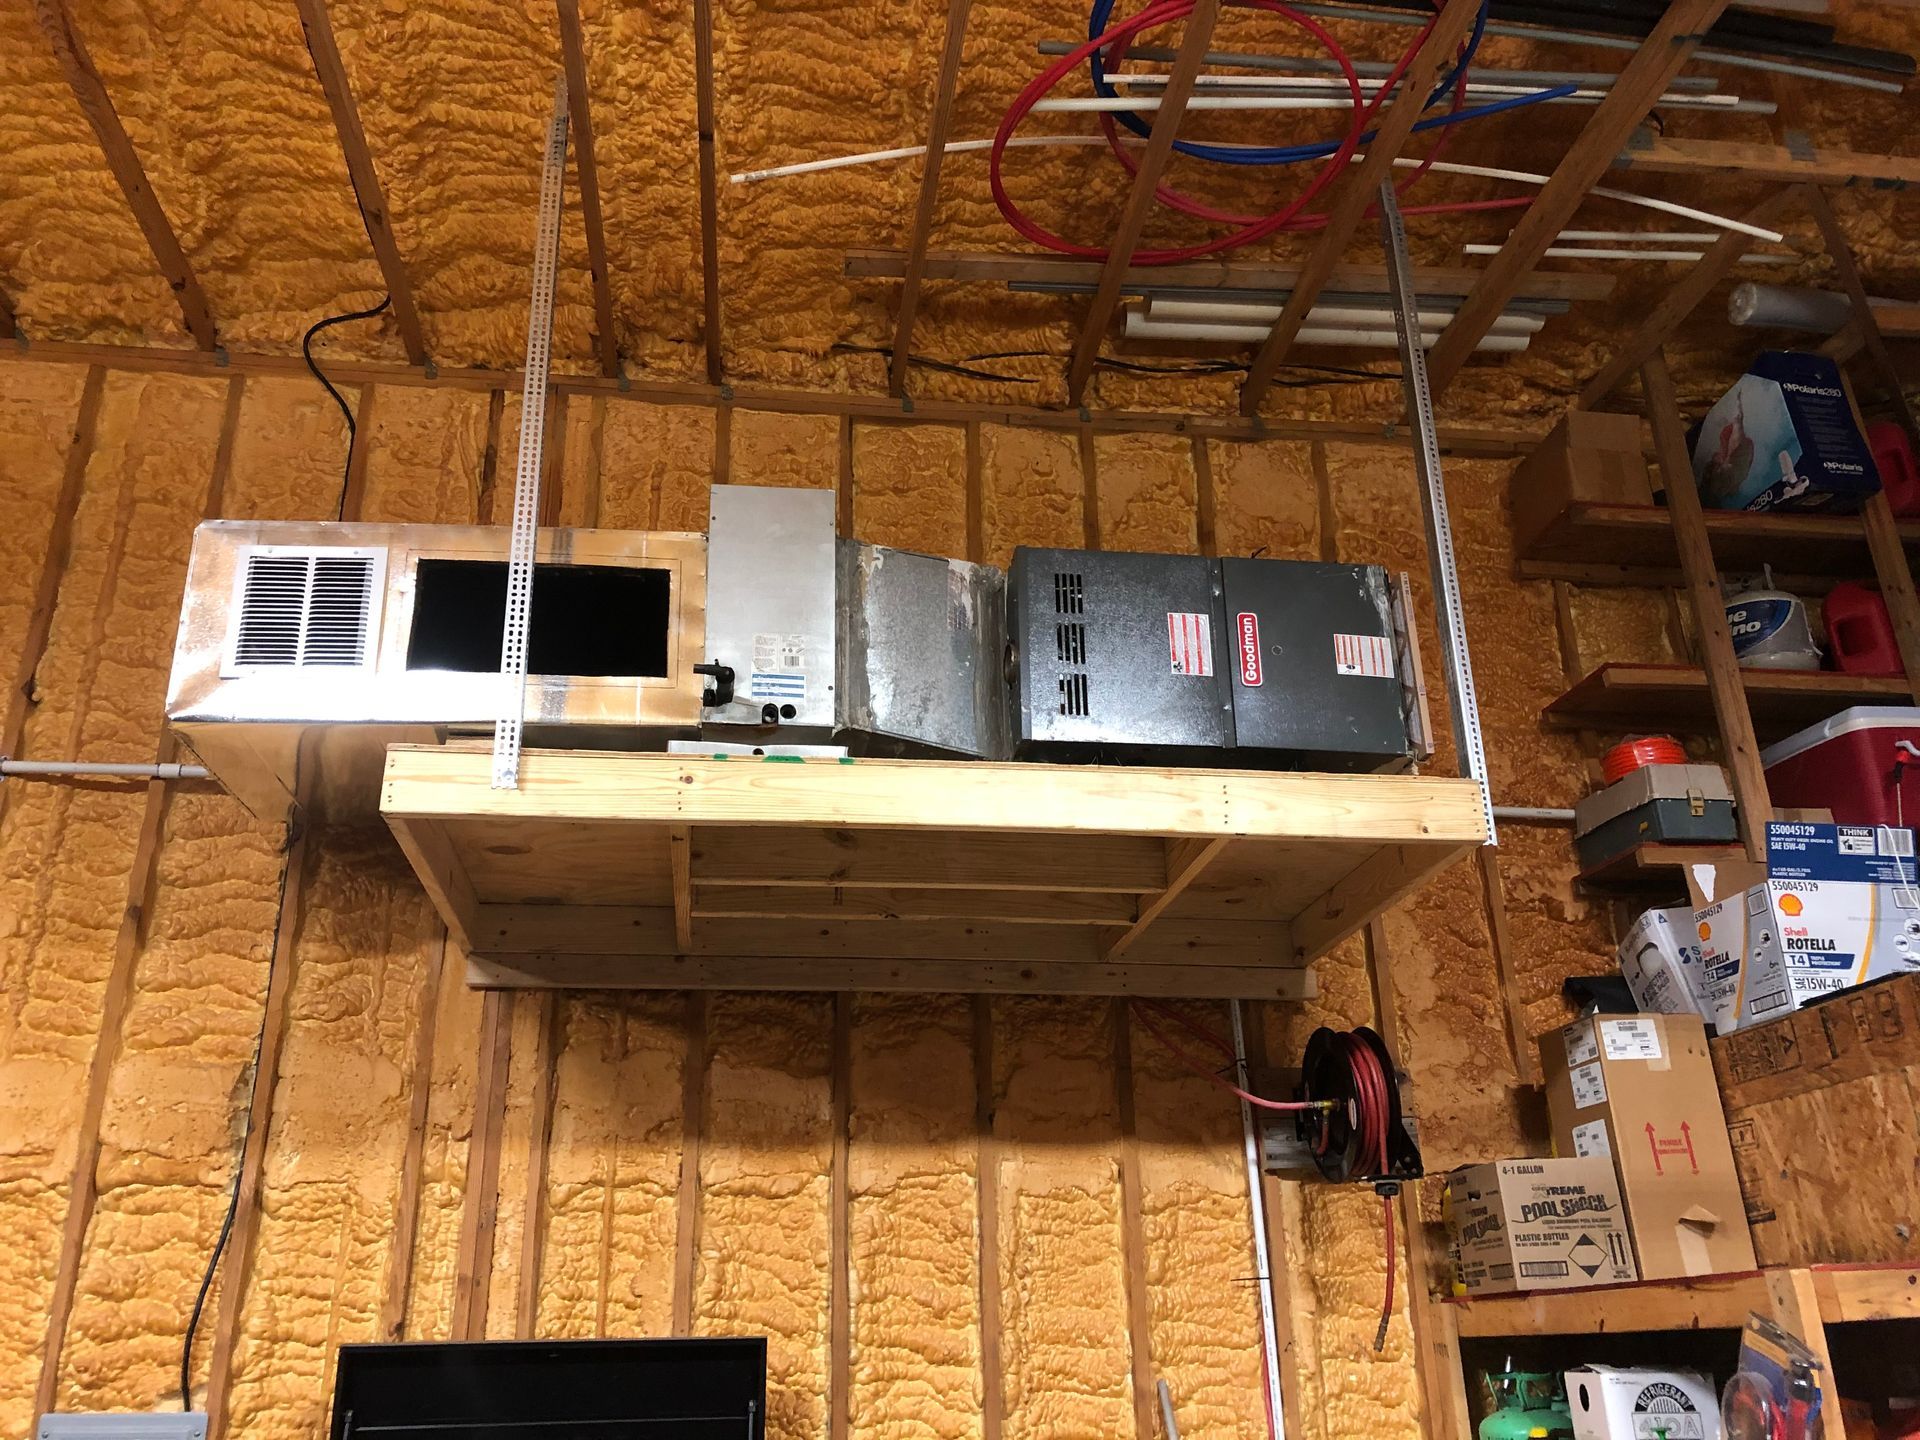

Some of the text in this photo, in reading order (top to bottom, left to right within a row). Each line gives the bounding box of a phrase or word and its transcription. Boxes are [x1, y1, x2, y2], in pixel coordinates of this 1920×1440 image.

[1833, 462, 1863, 472] Polaris
[1243, 617, 1257, 681] Goodman
[1770, 825, 1815, 836] 550045129
[1771, 842, 1806, 851] SAE 15W-40
[1773, 881, 1819, 892] 550045129
[1695, 903, 1723, 922] 550045129
[1784, 927, 1808, 936] Shell
[1787, 938, 1836, 951] ROTELLA
[1705, 951, 1730, 969] ROTELLA
[1789, 955, 1806, 965] T4
[1706, 971, 1715, 980] T4
[1794, 977, 1807, 989] SAE
[1806, 977, 1844, 991] 15W-40
[1502, 1165, 1544, 1175] 4-1 GALLON
[1521, 1194, 1607, 1223] POOL SHOCK
[1515, 1232, 1570, 1242] PLASTIC BOTTLES
[1637, 1383, 1693, 1409] REFRIGERANT
